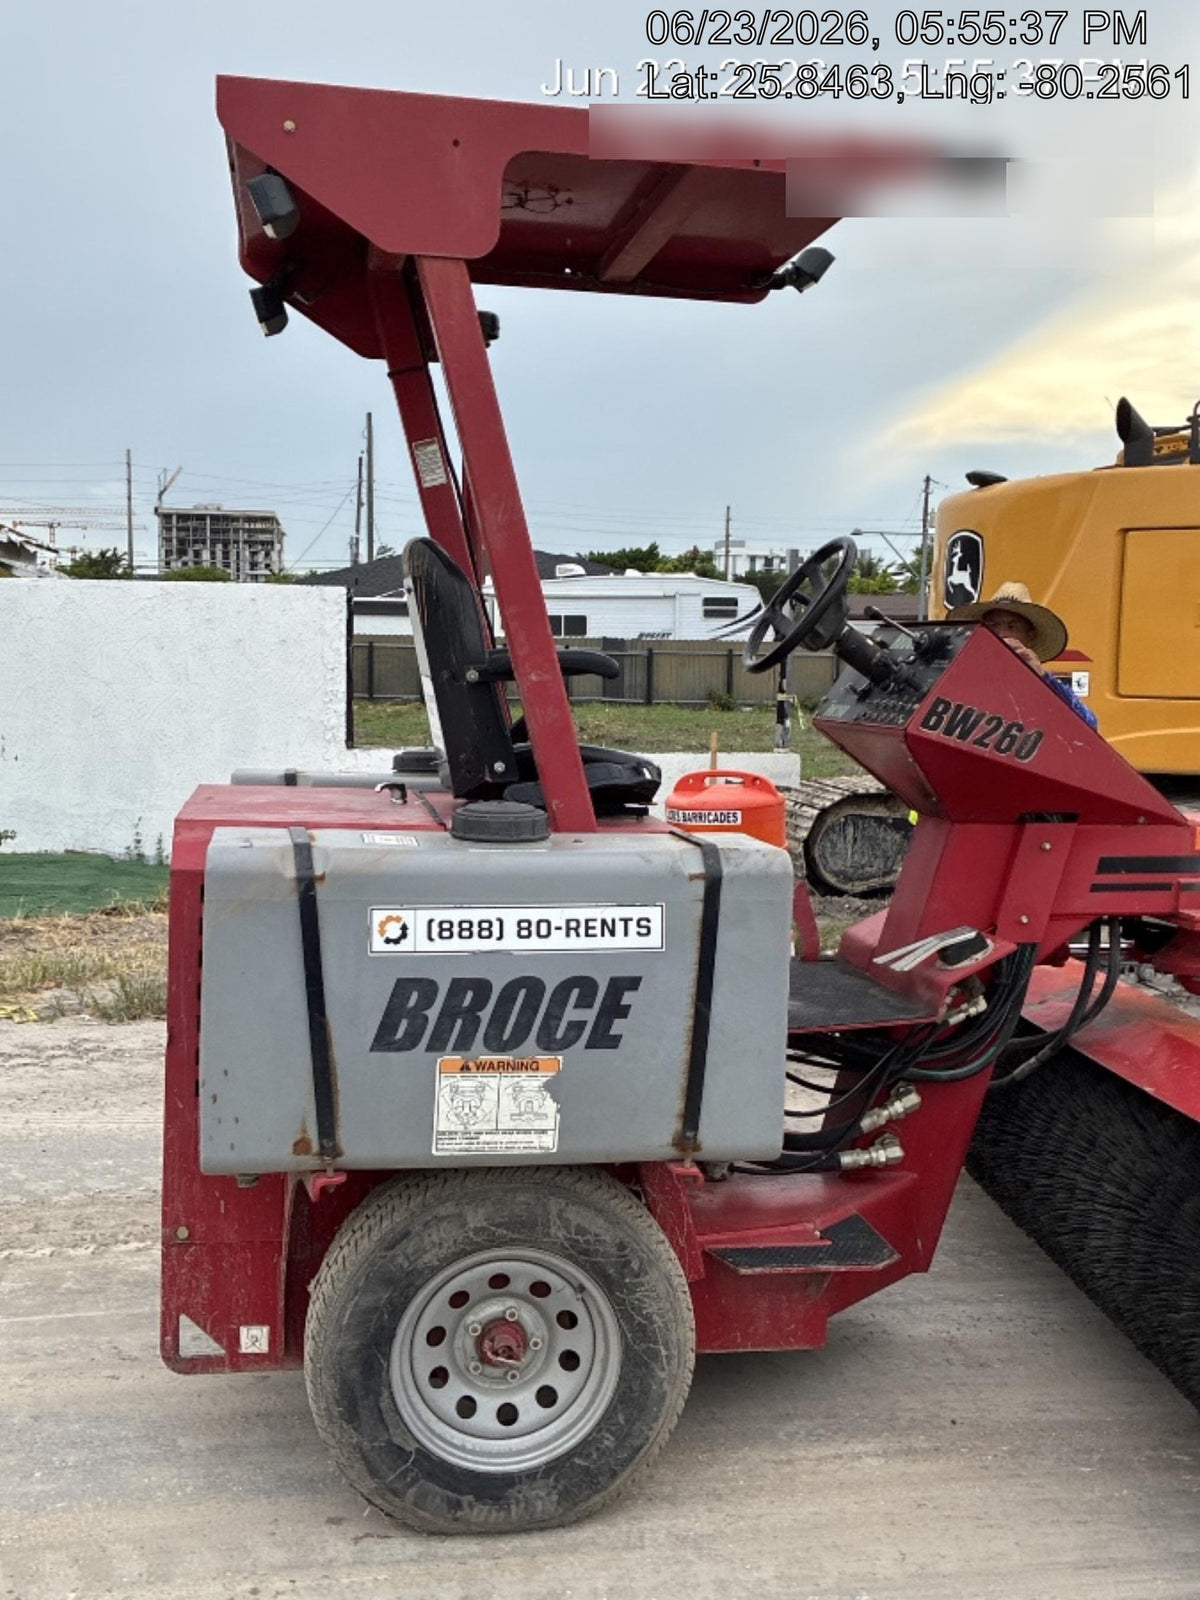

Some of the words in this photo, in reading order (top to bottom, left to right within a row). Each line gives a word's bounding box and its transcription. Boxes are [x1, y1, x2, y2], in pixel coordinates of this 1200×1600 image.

[920, 697, 1044, 762] BW260
[682, 811, 739, 824] BARRICADES
[426, 918, 504, 941] (888)
[516, 916, 652, 940] 80-RENTS
[369, 975, 643, 1053] BROCE
[474, 1060, 540, 1072] WARNING
